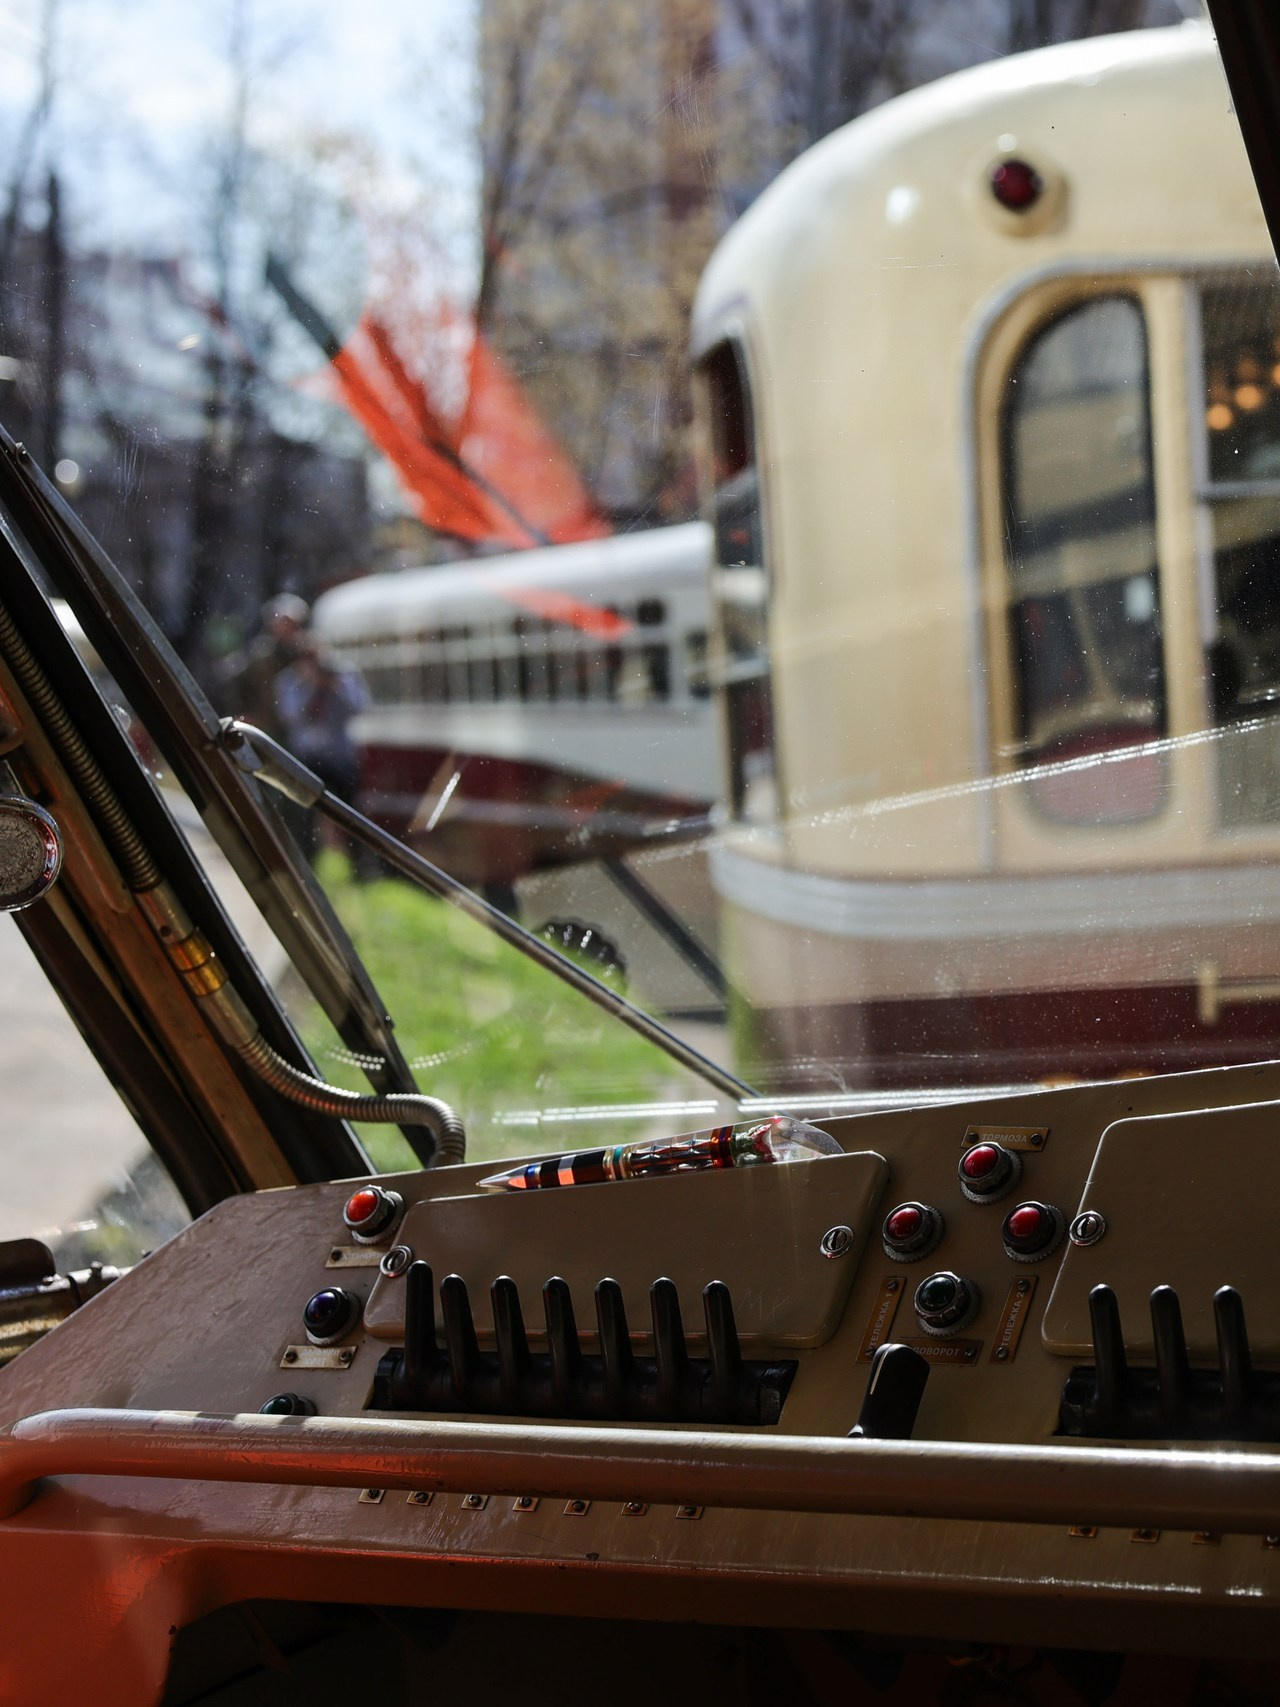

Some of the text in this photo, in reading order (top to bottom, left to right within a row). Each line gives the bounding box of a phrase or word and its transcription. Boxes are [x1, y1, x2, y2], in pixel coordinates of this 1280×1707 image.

[982, 1132, 1028, 1143] ТОРМОЗА
[869, 1301, 890, 1347] ТЕЛЕЖКА
[999, 1300, 1022, 1347] ТЕЛЕЖКА
